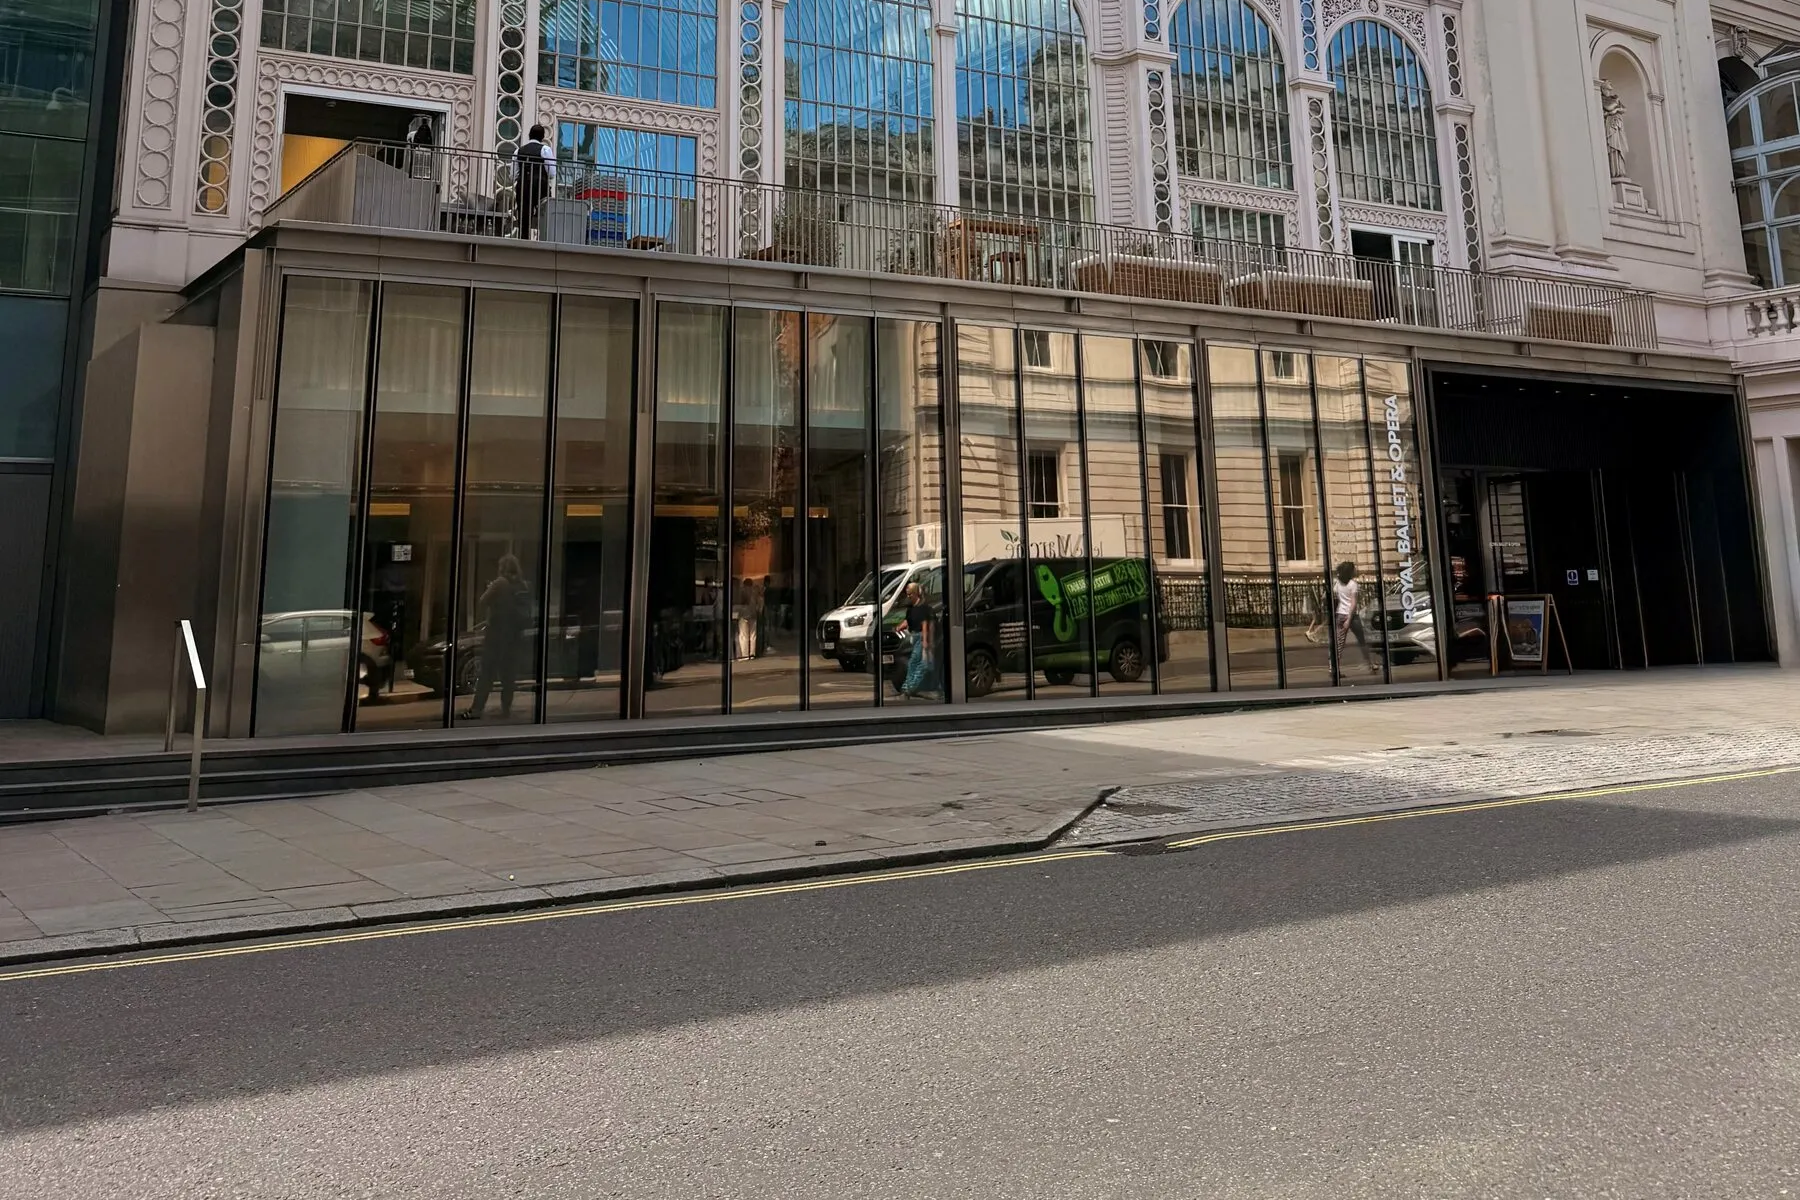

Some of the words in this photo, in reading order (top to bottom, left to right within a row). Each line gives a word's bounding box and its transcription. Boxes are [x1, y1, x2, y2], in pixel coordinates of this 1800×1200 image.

[1385, 394, 1402, 462] OPERA
[1391, 464, 1405, 482] &
[1392, 483, 1411, 553] BALLET
[1400, 557, 1416, 623] ROYAL
